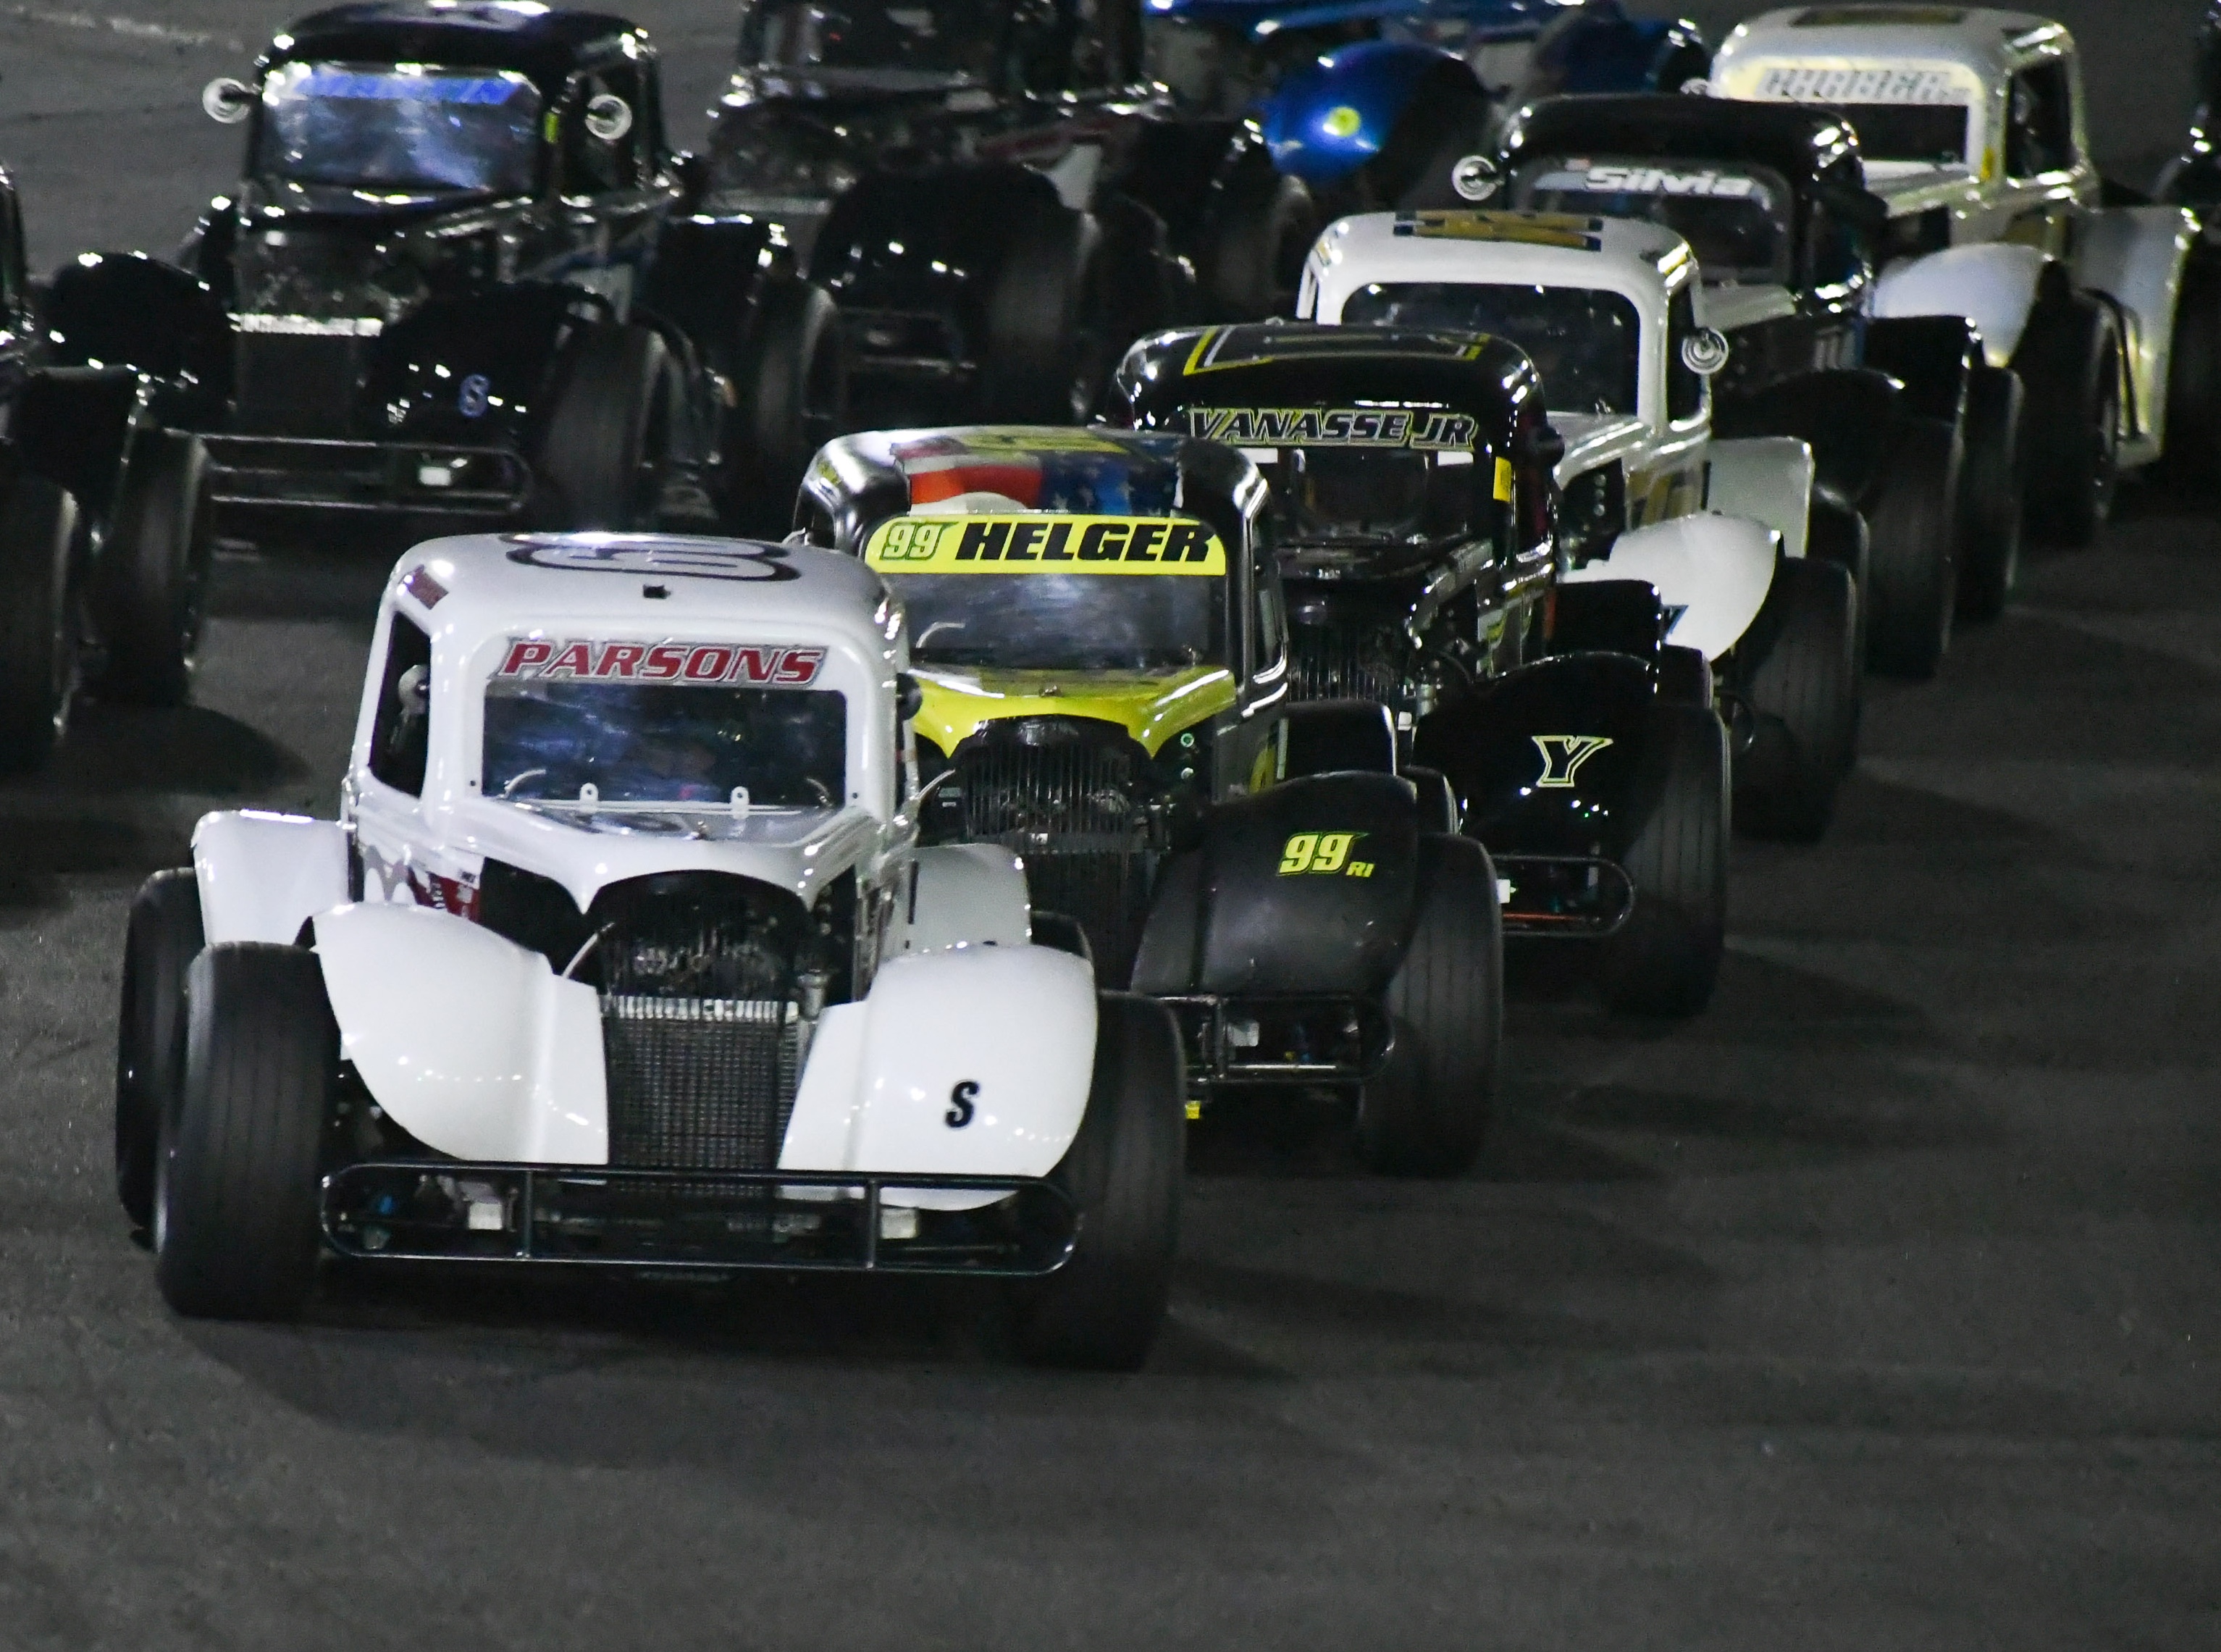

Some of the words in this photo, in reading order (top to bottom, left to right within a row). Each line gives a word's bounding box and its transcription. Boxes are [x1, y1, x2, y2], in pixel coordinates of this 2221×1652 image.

[1188, 407, 1411, 447] VANASSE
[1411, 411, 1478, 452] JR
[879, 521, 947, 561] 99
[954, 521, 1217, 562] HELGER
[497, 640, 826, 684] PARSONS
[1532, 735, 1613, 787] Y
[1277, 831, 1355, 875] 99
[944, 1080, 980, 1129] S
